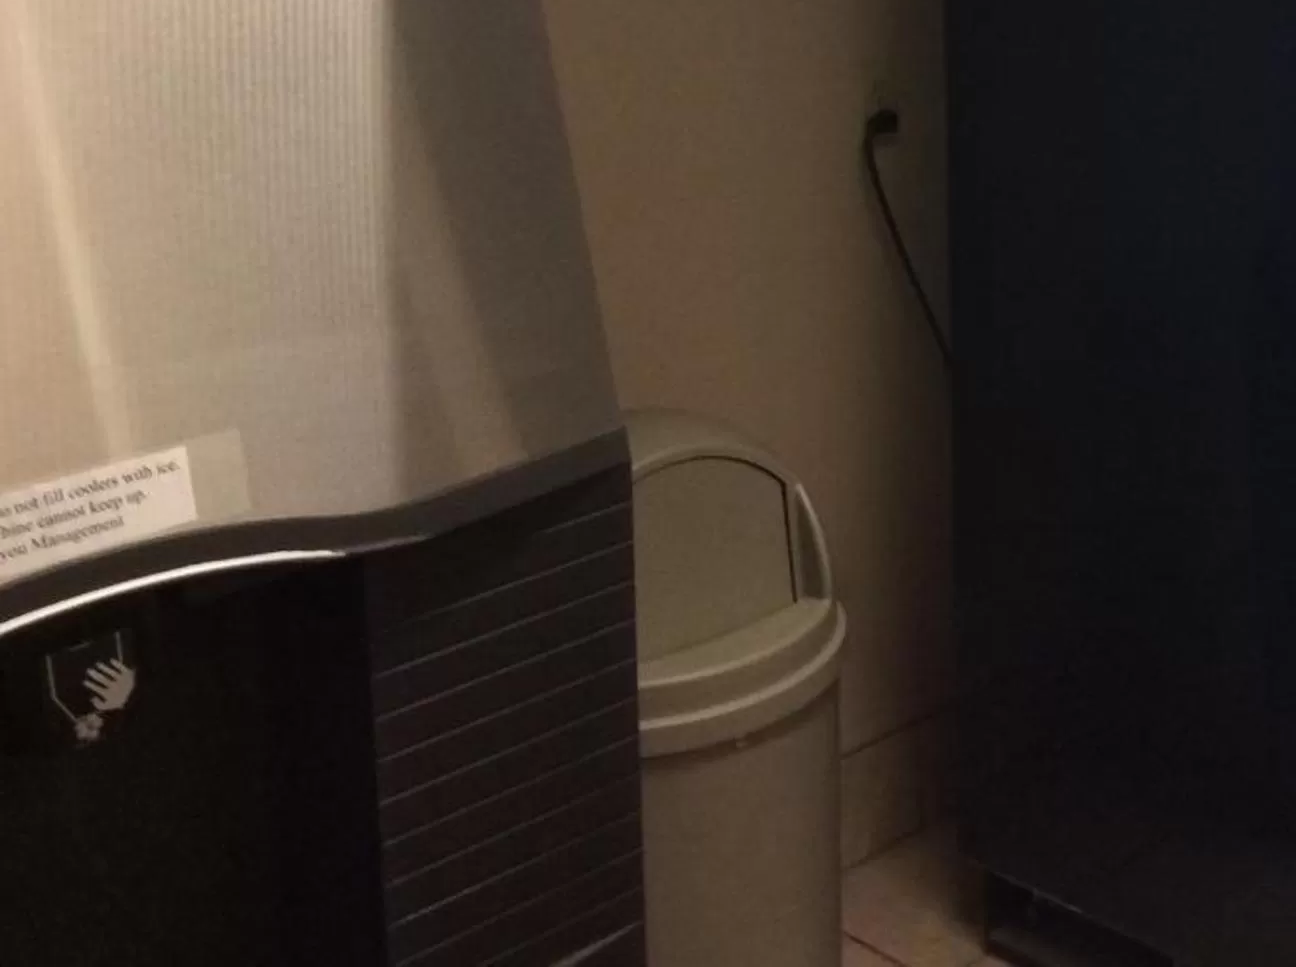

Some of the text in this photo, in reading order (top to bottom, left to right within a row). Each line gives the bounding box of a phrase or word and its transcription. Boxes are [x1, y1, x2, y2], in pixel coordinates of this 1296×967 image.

[14, 497, 39, 513] not
[42, 487, 65, 507] fill
[121, 465, 152, 484] with
[36, 504, 86, 528] cannot
[88, 496, 123, 514] keep
